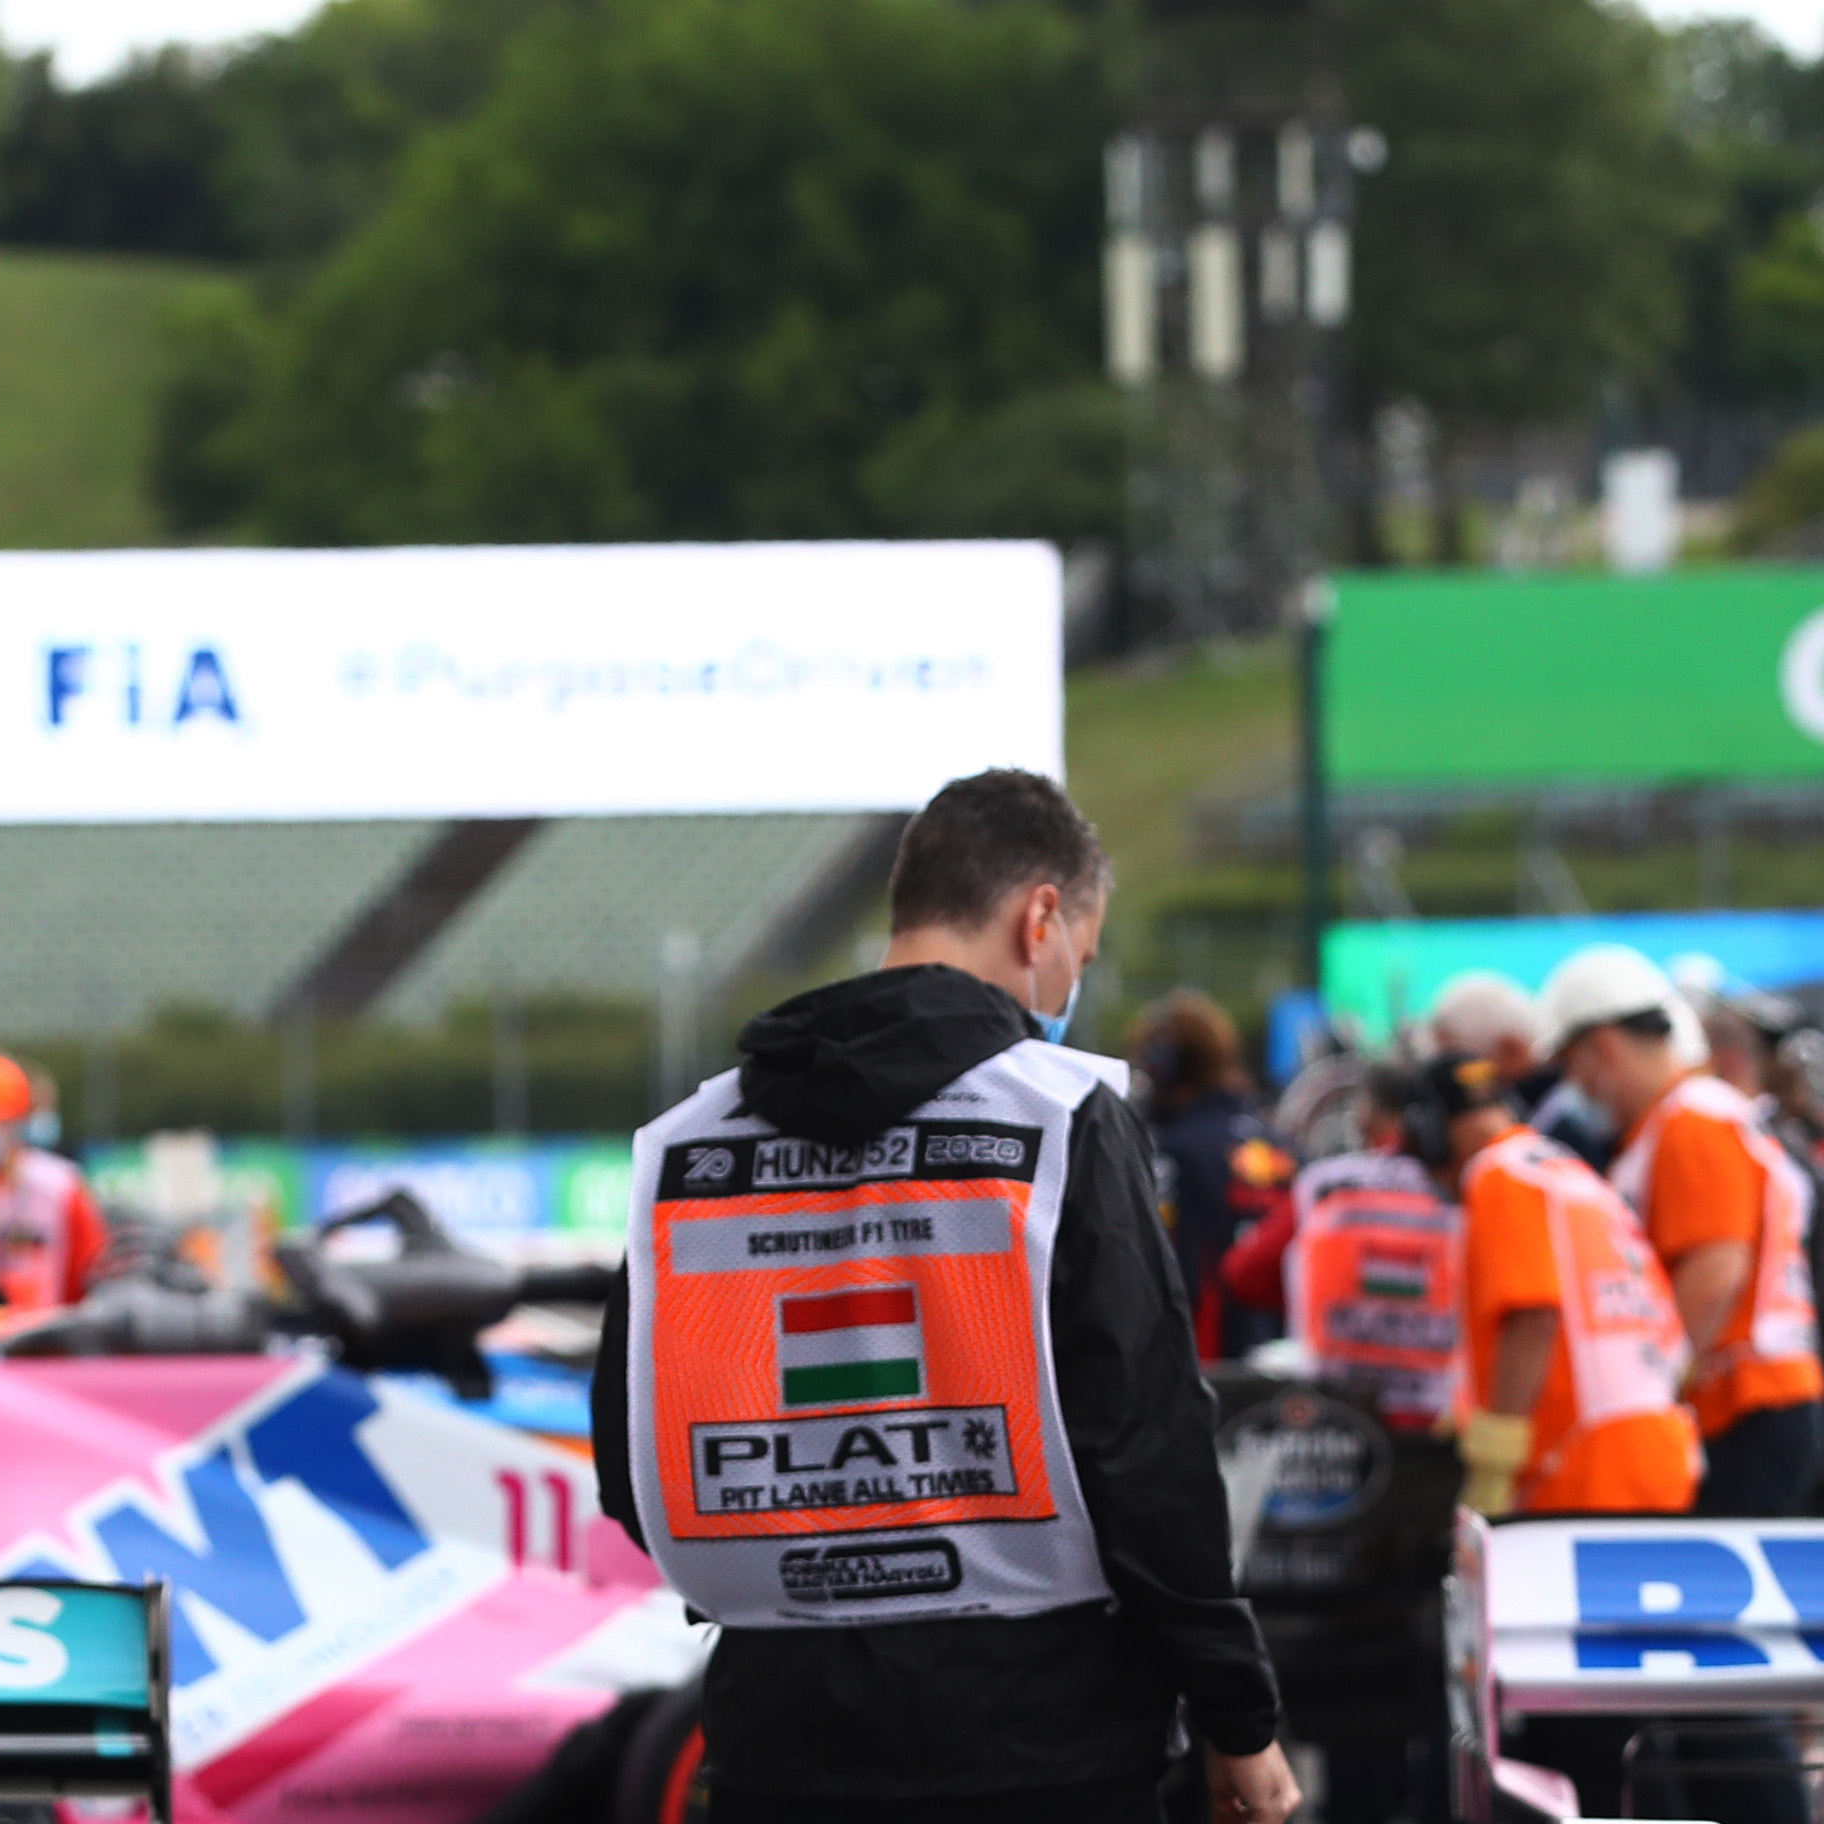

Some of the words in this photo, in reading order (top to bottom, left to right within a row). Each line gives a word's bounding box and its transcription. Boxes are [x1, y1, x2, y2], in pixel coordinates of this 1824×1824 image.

[923, 1134, 1026, 1168] 2020
[861, 1221, 883, 1243] F1
[890, 1217, 934, 1242] TYRE
[704, 1420, 950, 1476] PLAT
[720, 1485, 764, 1509] PIT
[770, 1480, 846, 1506] LANE
[853, 1477, 904, 1502] ALL
[908, 1469, 995, 1498] TIMES
[494, 1467, 574, 1573] 11
